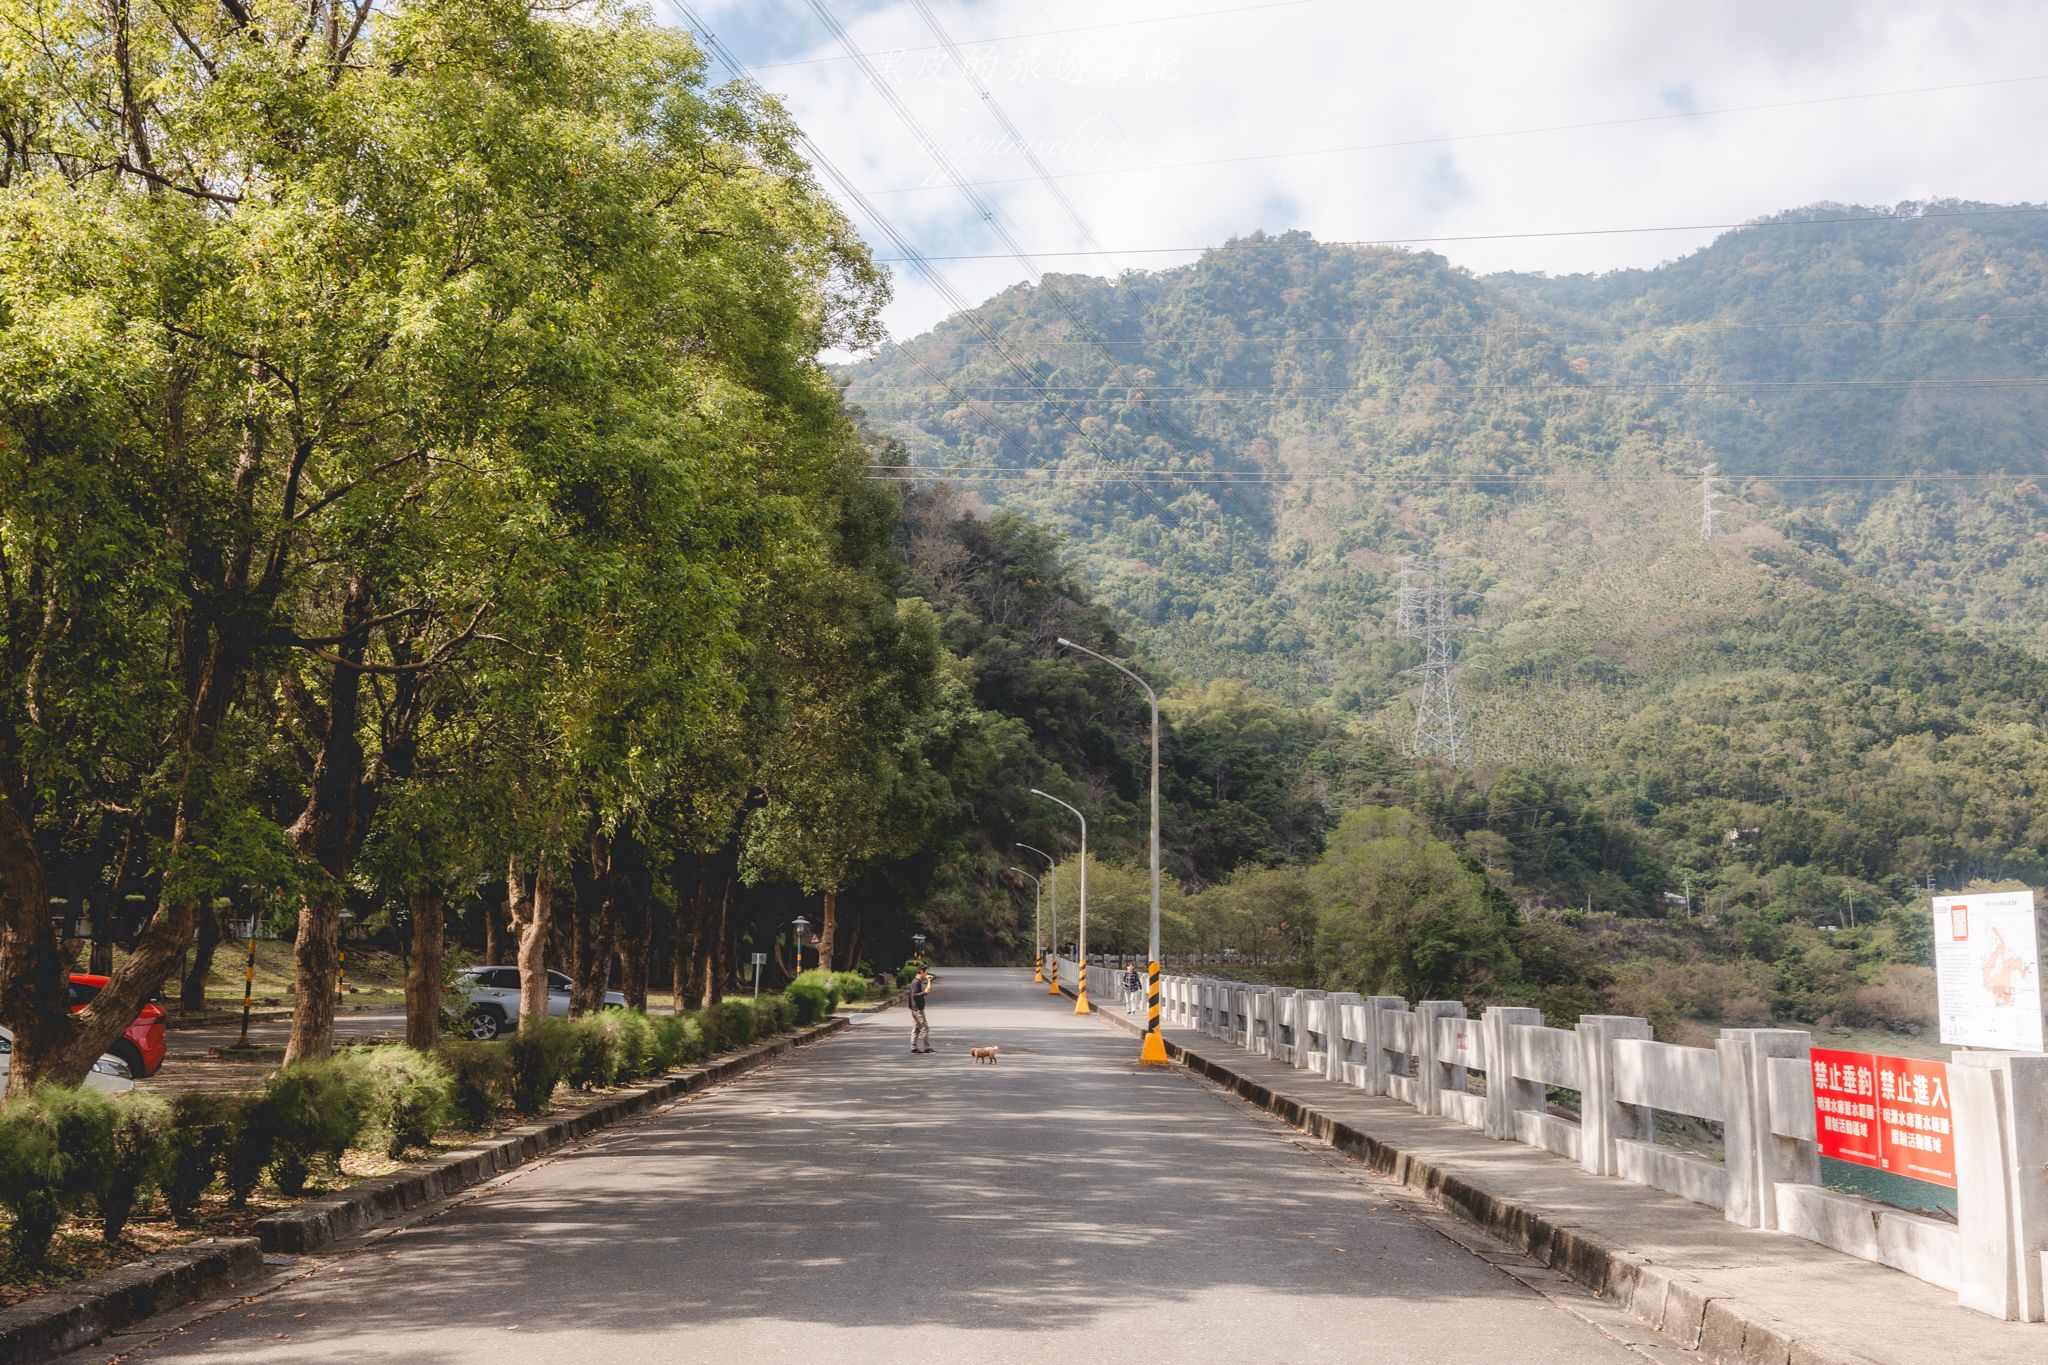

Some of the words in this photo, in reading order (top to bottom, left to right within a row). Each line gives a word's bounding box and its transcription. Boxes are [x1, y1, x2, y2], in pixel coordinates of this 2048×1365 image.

[1814, 1060, 1873, 1097] 禁止垂釣
[1880, 1069, 1948, 1109] 禁止進入
[1824, 1116, 1868, 1138] 限制活動區域
[1891, 1129, 1942, 1154] 限制活動區域
